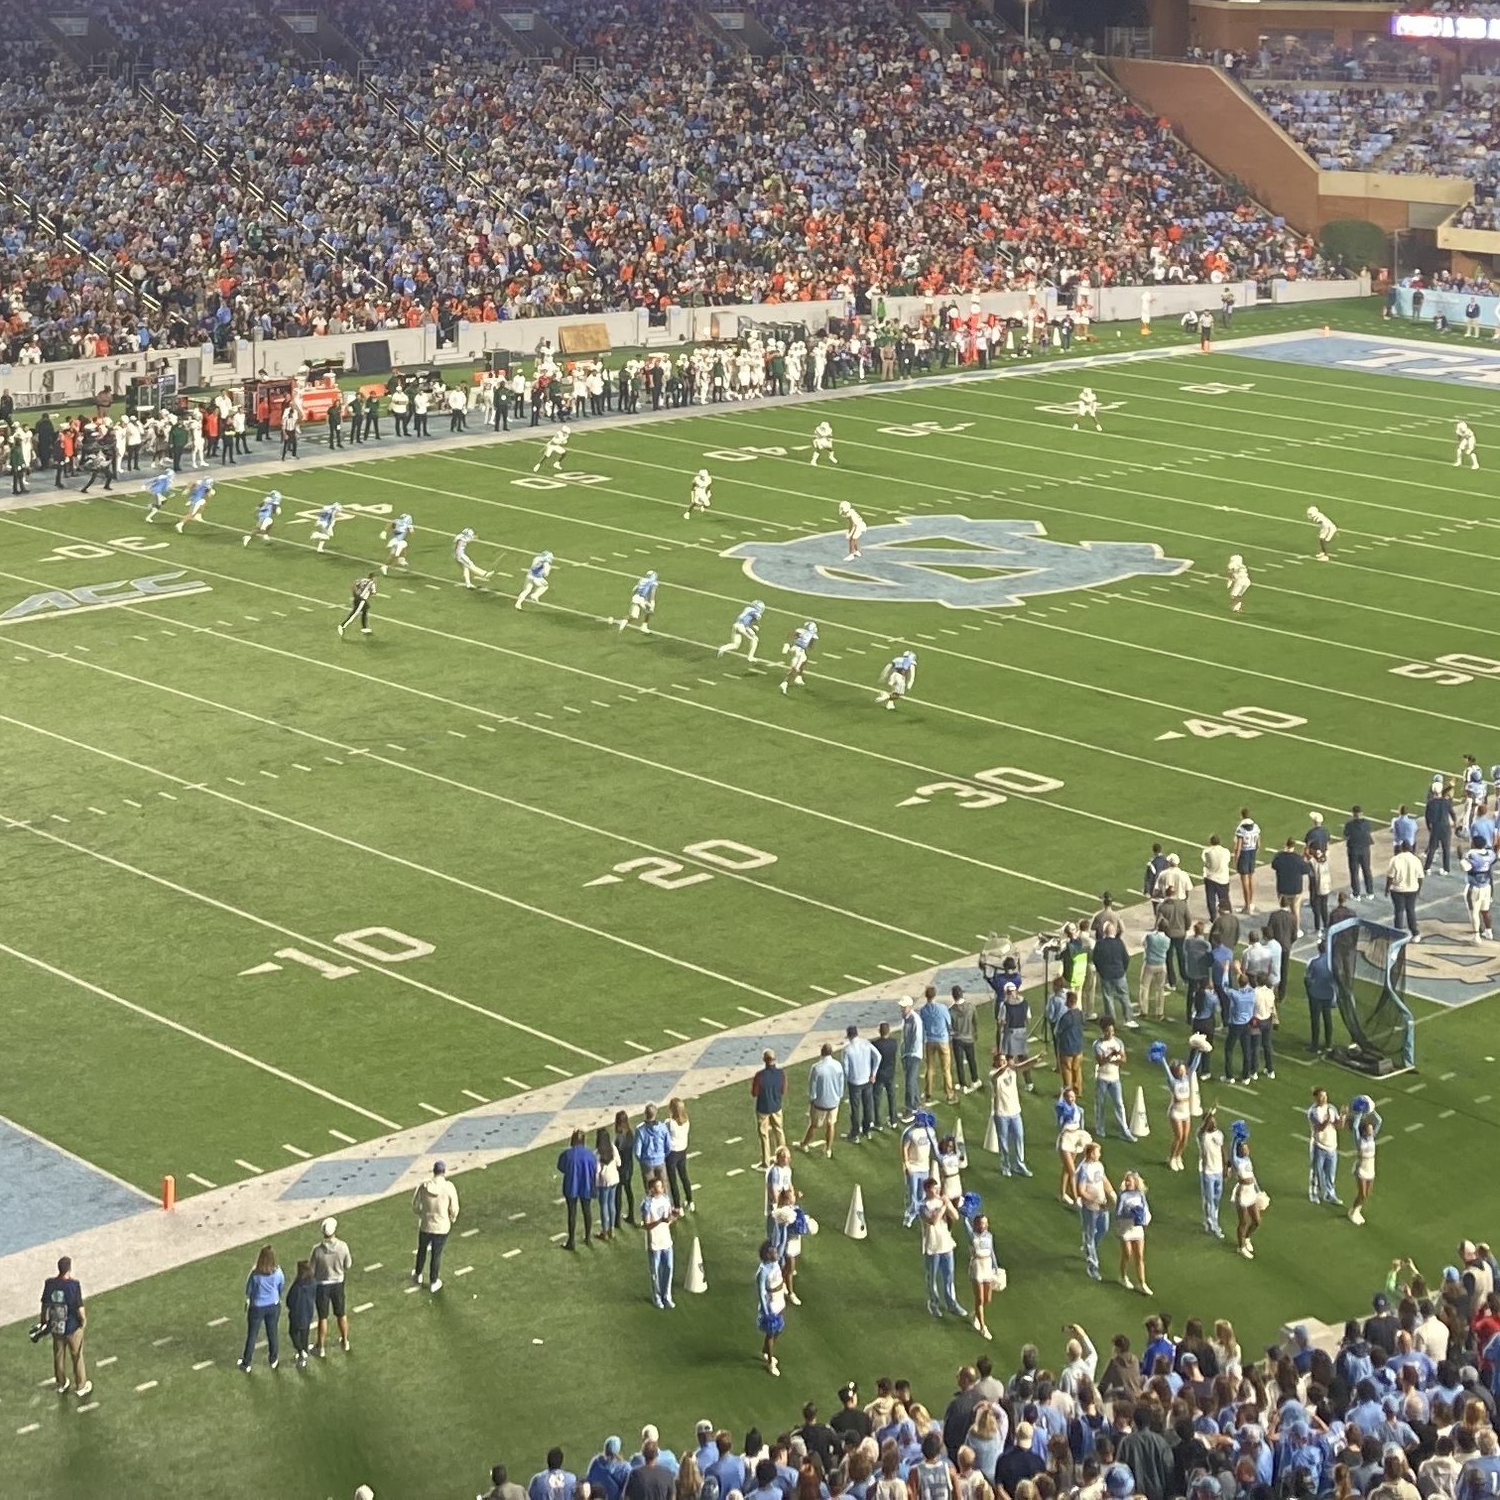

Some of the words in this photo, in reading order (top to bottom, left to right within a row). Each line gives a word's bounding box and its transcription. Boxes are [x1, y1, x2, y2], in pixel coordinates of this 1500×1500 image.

[510, 471, 612, 489] 50
[51, 536, 171, 560] 30
[1389, 653, 1500, 685] 50
[1183, 706, 1308, 739] 40
[916, 767, 1065, 808] 30
[614, 838, 778, 890] 20
[274, 926, 436, 979] 10
